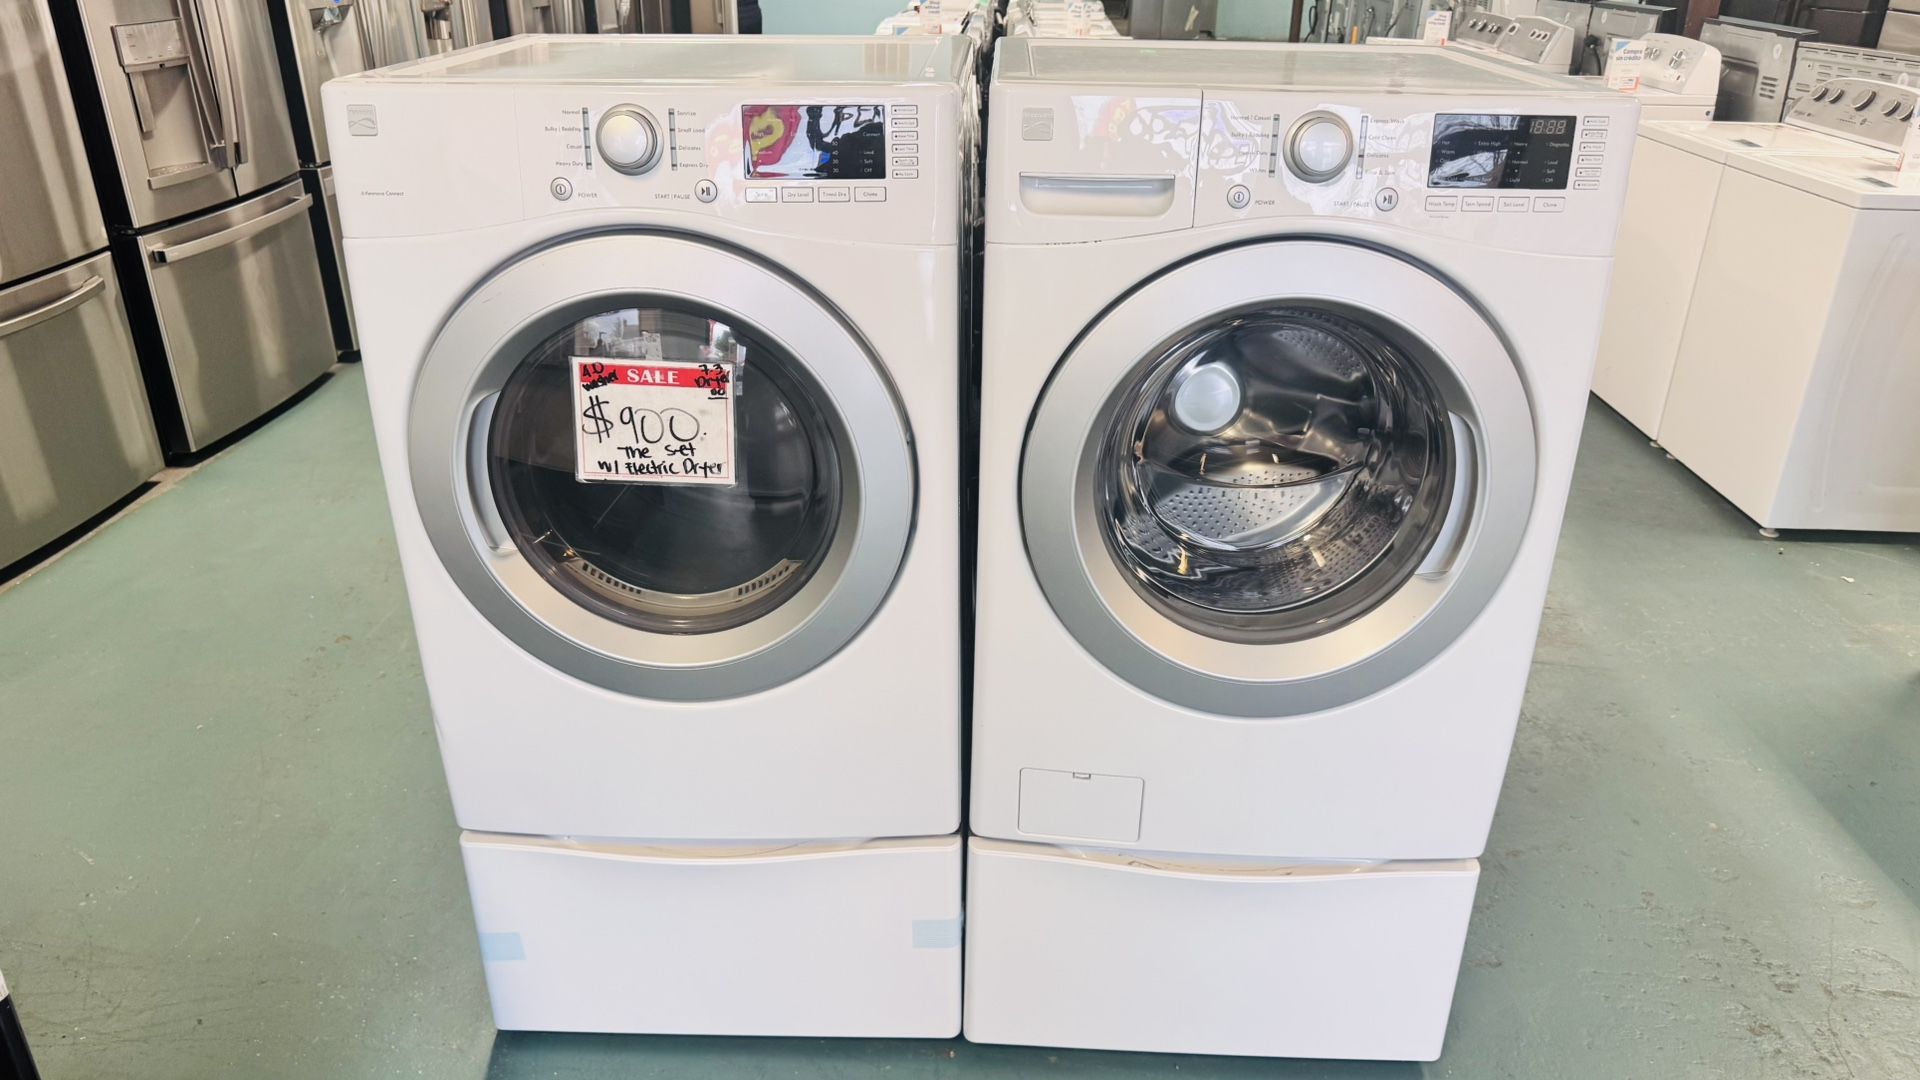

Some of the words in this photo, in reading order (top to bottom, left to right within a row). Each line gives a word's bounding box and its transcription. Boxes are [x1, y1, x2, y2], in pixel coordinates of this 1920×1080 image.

[626, 369, 680, 385] SALE
[617, 445, 652, 459] The
[625, 460, 680, 475] Electric
[682, 457, 726, 478] Dryer
